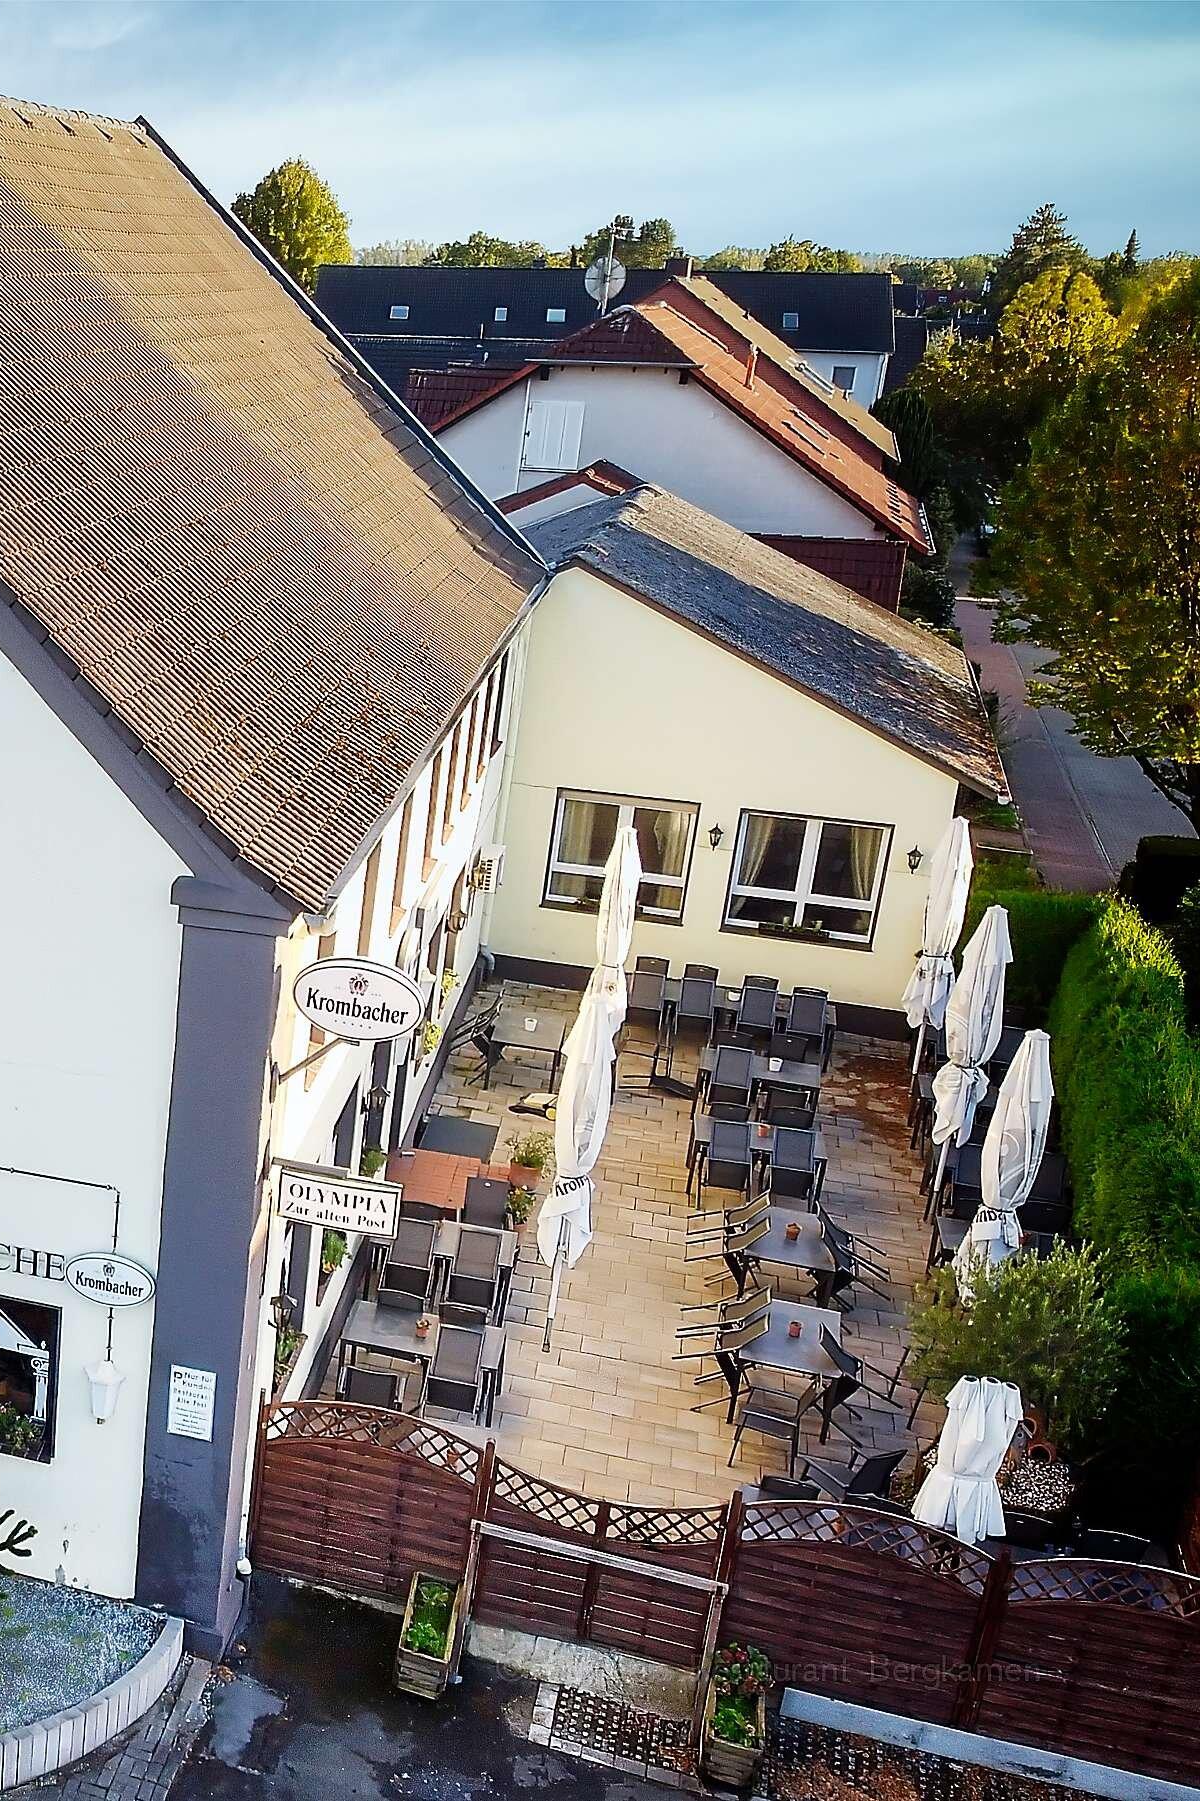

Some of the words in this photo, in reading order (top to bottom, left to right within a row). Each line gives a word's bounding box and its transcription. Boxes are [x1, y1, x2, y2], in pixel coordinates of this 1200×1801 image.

[306, 987, 409, 1025] Krombacher
[289, 1183, 387, 1213] OLYMPIA
[286, 1202, 310, 1215] Zur
[316, 1209, 350, 1224] alten
[357, 1215, 385, 1229] Post
[75, 1270, 145, 1298] Krombacher
